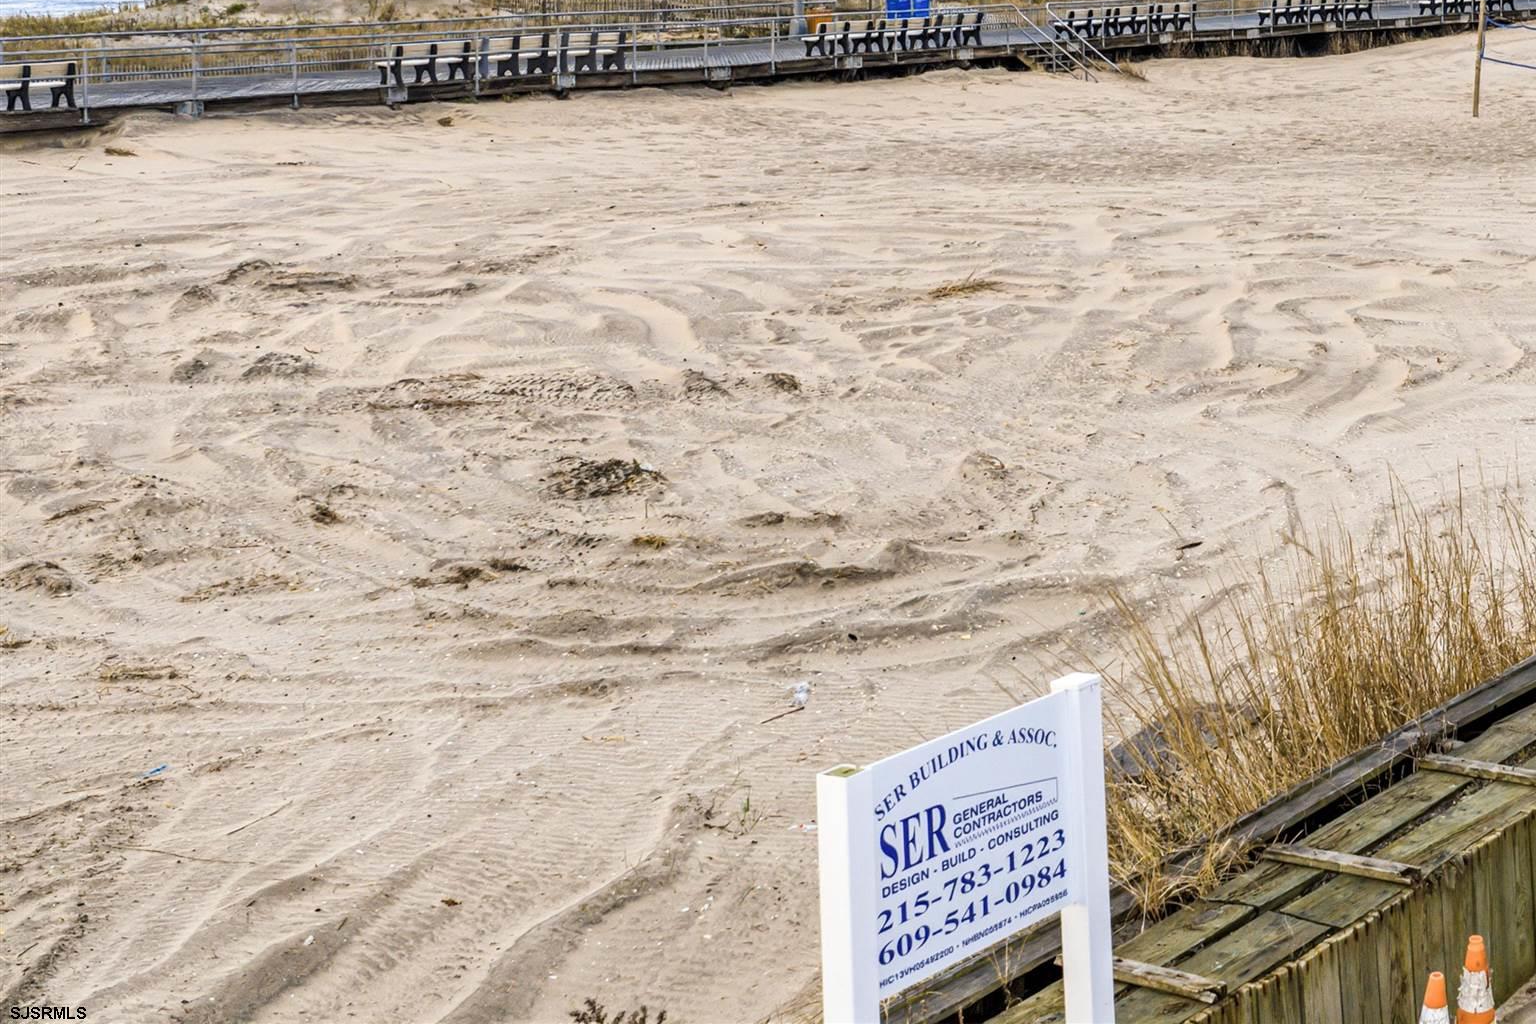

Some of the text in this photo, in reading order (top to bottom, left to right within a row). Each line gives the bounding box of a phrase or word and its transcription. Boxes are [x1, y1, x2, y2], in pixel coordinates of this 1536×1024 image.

[873, 726, 1058, 822] SER BUILDING & ASSOC.
[952, 792, 1009, 825] GENERAL
[952, 790, 1044, 839] CONTRACTORS
[877, 828, 1067, 935] 215-783-1223
[879, 803, 951, 881] SER
[881, 867, 931, 899] DESIGN
[941, 847, 977, 872] BUILD
[987, 809, 1060, 851] CONSULTING
[878, 857, 1068, 967] 609-541-0984
